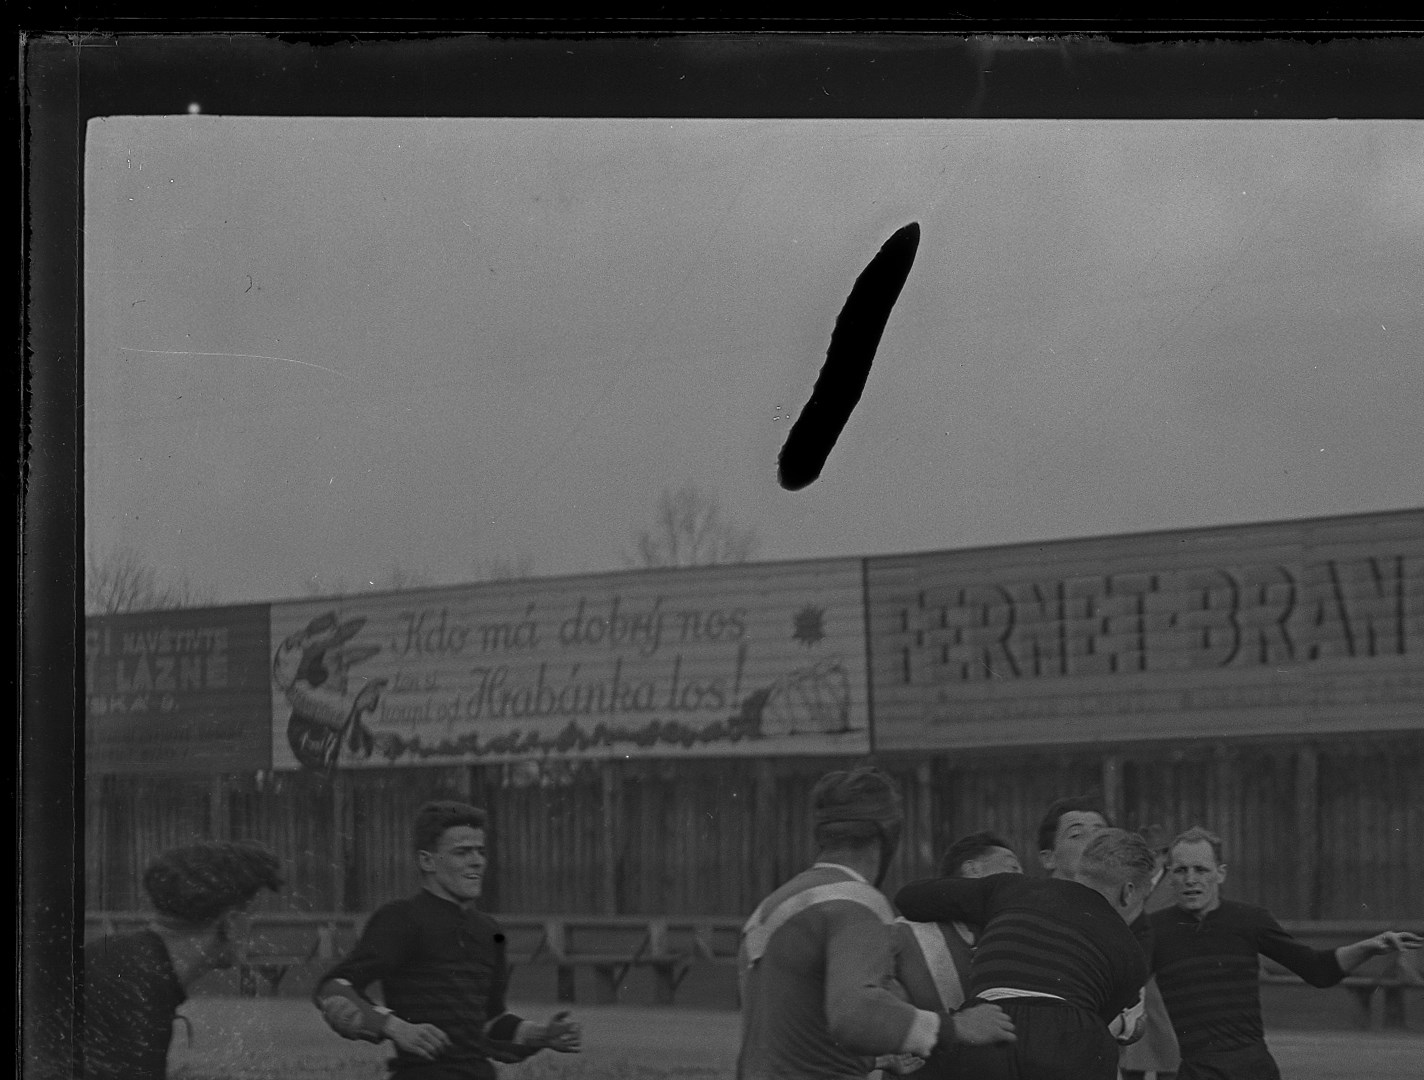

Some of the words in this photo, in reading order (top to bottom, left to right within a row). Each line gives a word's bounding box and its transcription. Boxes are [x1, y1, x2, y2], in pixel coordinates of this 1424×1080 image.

[392, 606, 472, 655] Kdo
[478, 602, 541, 652] má
[559, 596, 664, 658] dobrý
[676, 606, 748, 641] nos
[466, 656, 656, 718] Hrabánka
[667, 643, 749, 711] los!
